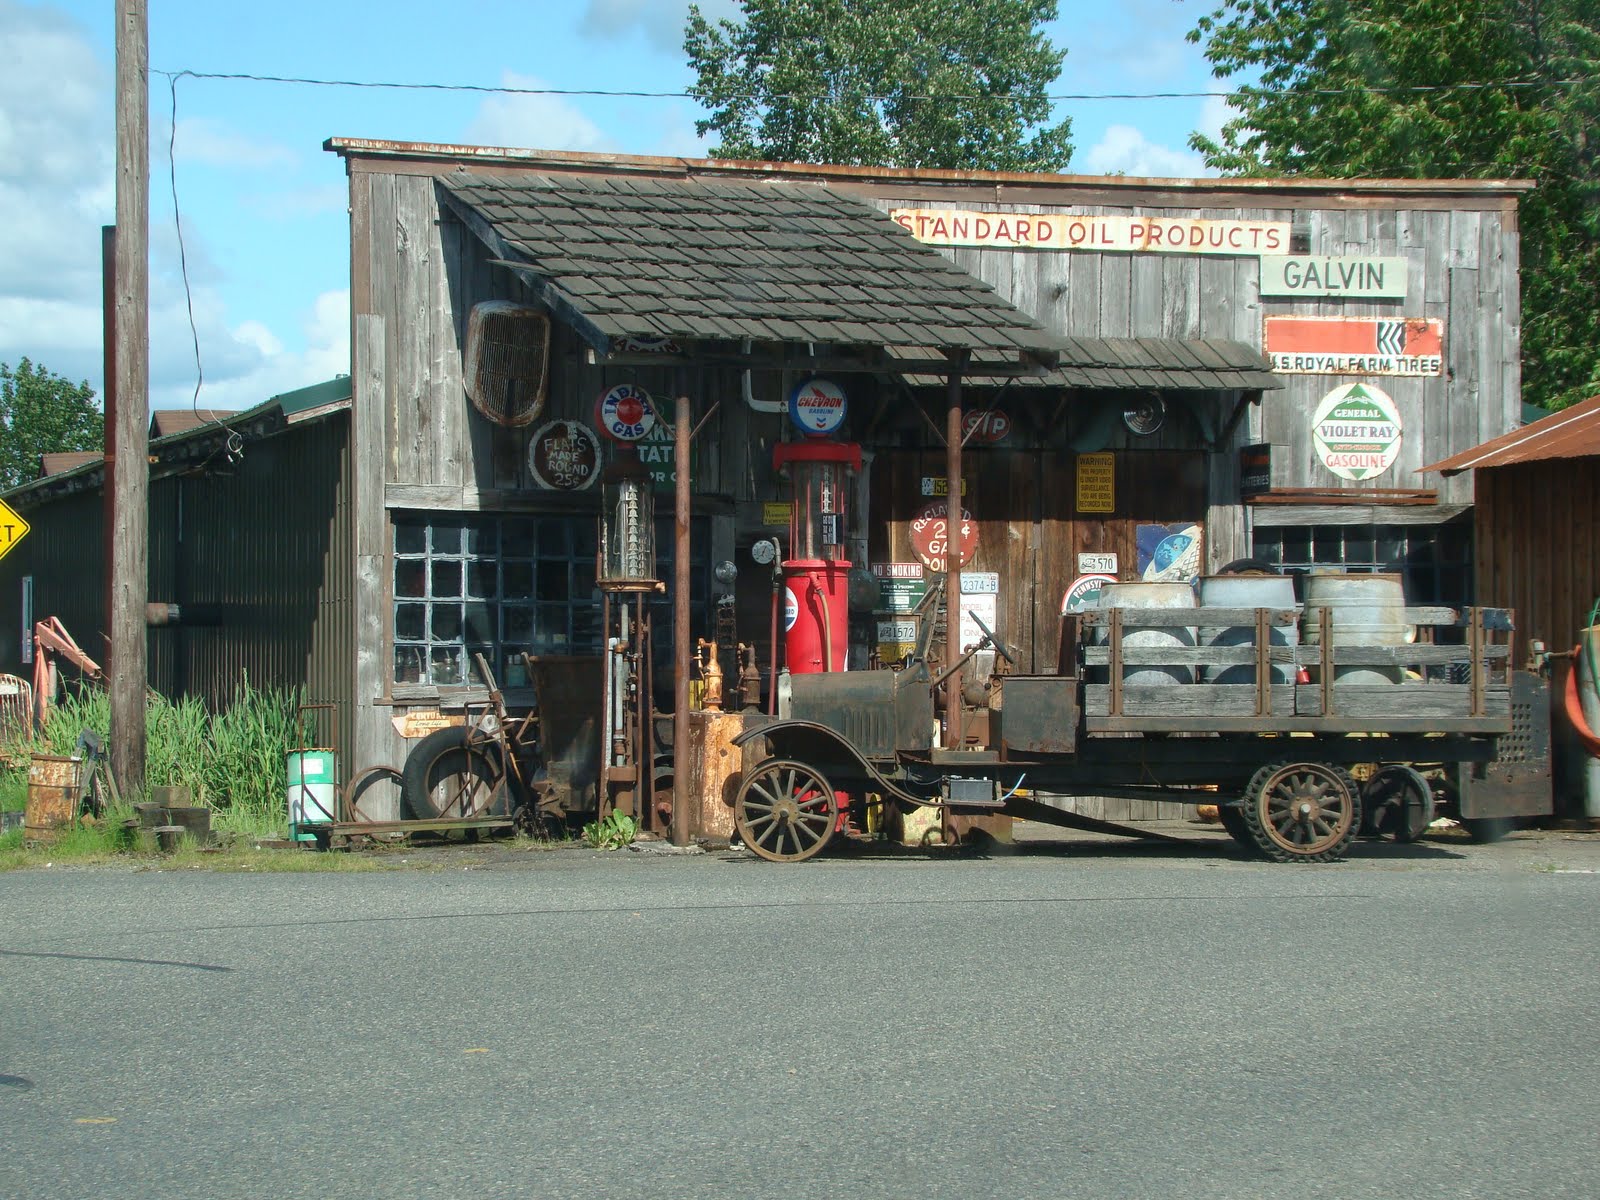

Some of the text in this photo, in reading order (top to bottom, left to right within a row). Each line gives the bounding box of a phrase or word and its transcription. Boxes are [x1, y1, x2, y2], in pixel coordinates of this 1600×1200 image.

[898, 215, 1280, 249] STANDARD OIL PRODUCTS
[1284, 261, 1384, 290] GALVIN
[1349, 357, 1391, 371] FARM
[1396, 358, 1440, 372] TIRES
[798, 397, 843, 408] CHEVRON
[1334, 409, 1381, 418] GENERAL
[612, 422, 645, 438] GAS
[1320, 425, 1395, 438] VIOLET RAY
[544, 437, 587, 453] FLATS
[549, 450, 580, 462] MADE
[1080, 457, 1112, 466] WARNING
[1326, 454, 1388, 467] GASOLINE
[548, 460, 589, 476] ROUND
[1098, 557, 1113, 570] 570
[873, 564, 921, 577] NO SMOKING
